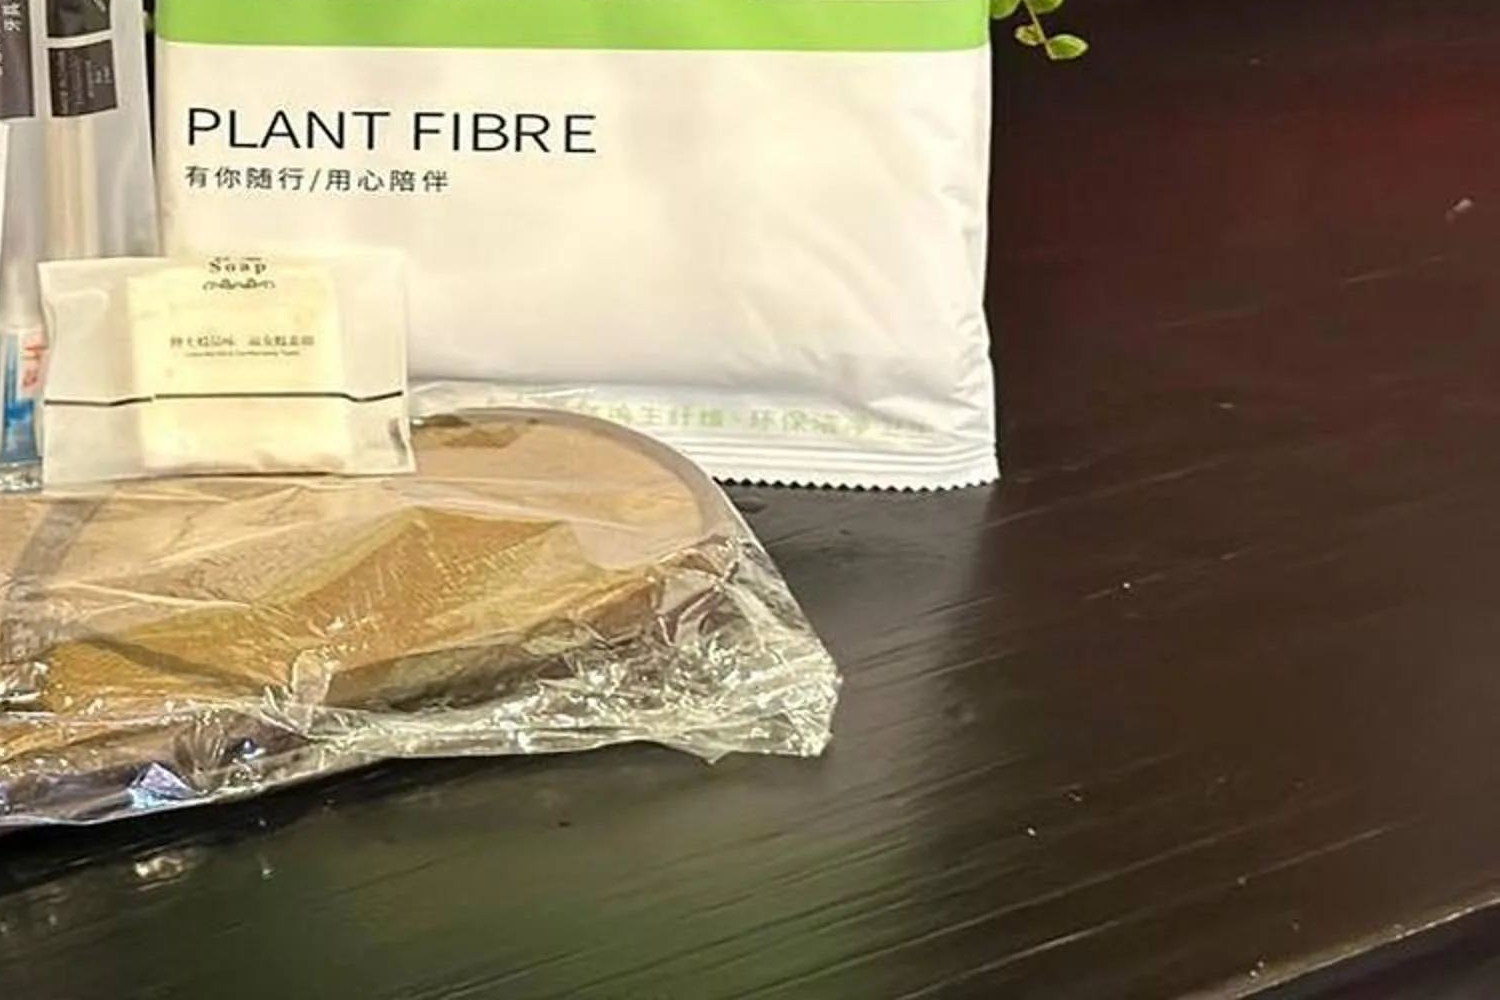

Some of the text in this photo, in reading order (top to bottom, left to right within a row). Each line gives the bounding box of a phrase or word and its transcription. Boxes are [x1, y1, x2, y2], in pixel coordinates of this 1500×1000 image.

[188, 107, 598, 153] PLANT FIBRE
[184, 165, 449, 192] 有你随行/用心陪伴
[208, 262, 267, 275] Soap
